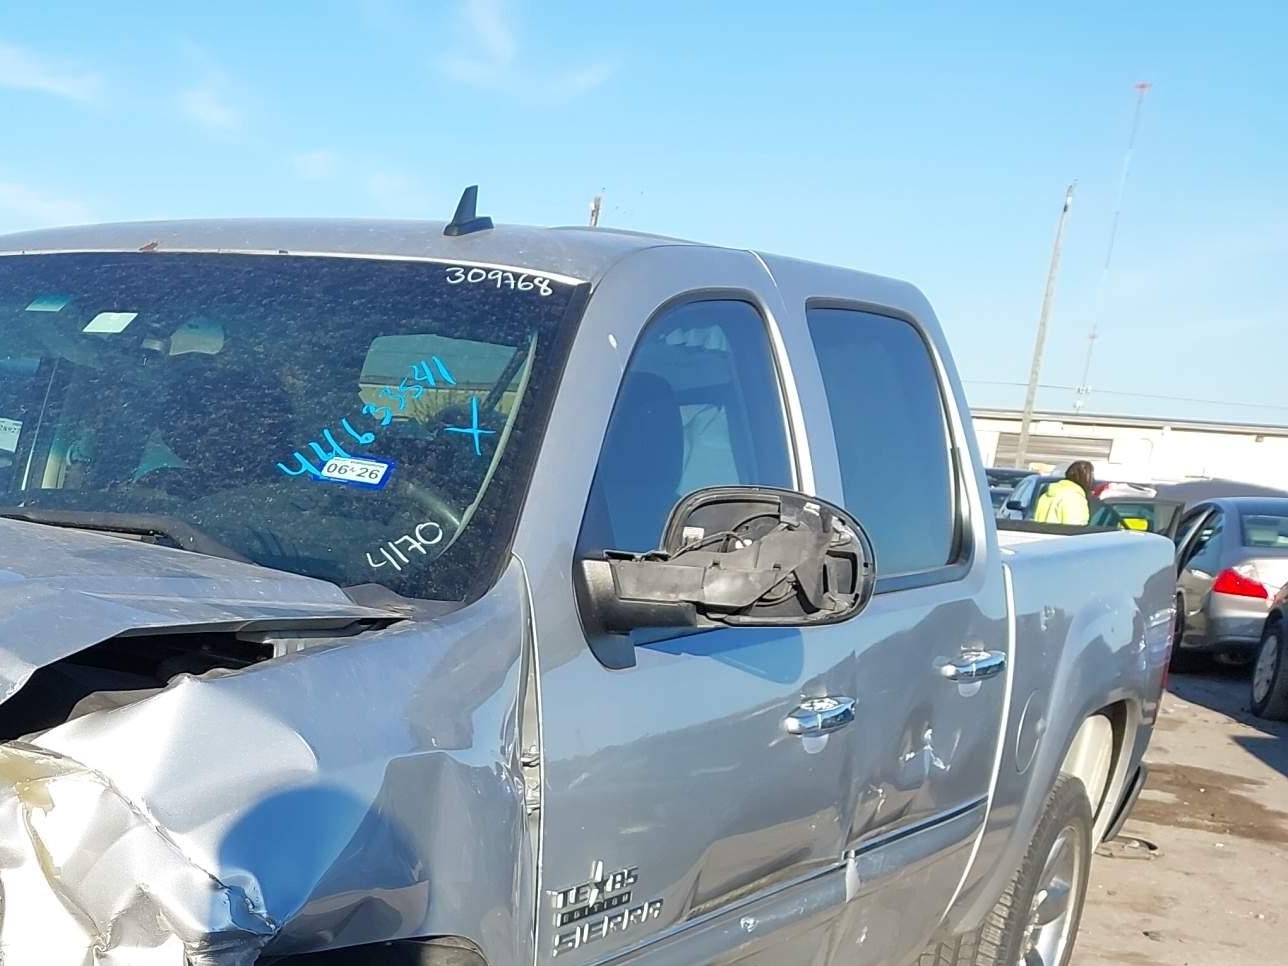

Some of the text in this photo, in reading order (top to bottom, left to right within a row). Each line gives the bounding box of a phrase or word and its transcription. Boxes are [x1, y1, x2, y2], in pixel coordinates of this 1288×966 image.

[446, 267, 553, 296] 309768
[367, 522, 443, 570] 4170
[547, 861, 638, 909] TEXAS
